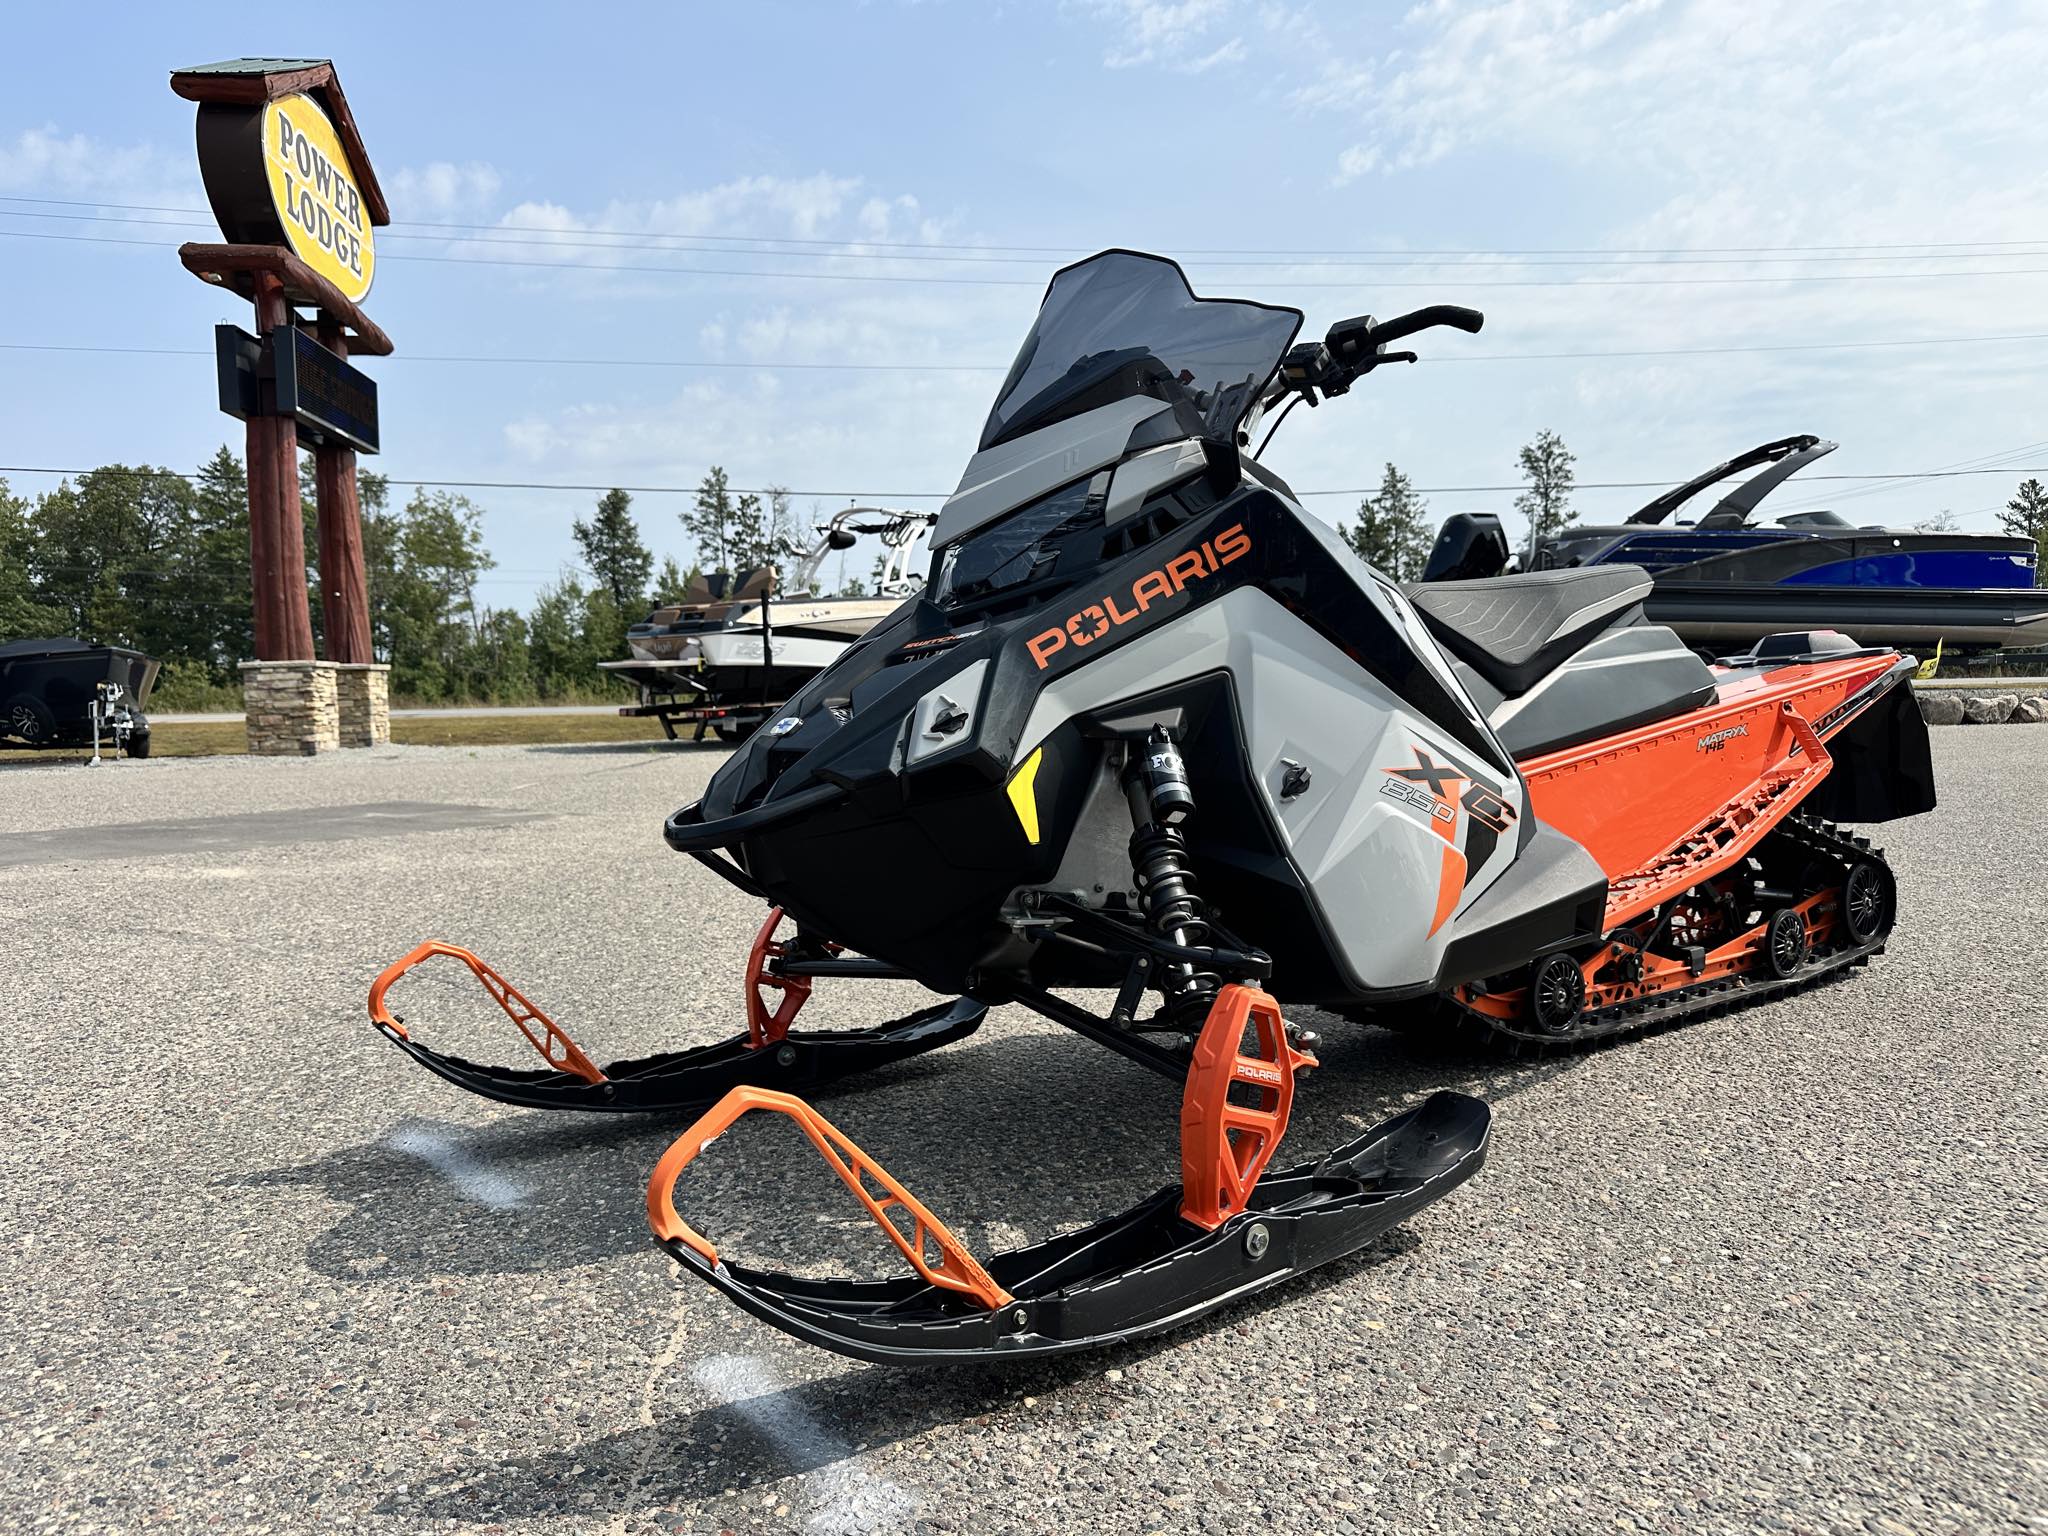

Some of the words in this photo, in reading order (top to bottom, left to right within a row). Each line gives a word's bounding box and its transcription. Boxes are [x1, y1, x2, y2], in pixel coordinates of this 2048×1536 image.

[279, 110, 362, 232] POWER
[284, 172, 362, 278] LODGE
[1025, 523, 1252, 670] POLARIS
[1696, 723, 1750, 752] MATRYX
[1705, 740, 1725, 755] 146
[1378, 777, 1457, 824] 850
[1237, 1065, 1281, 1082] POLARIS
